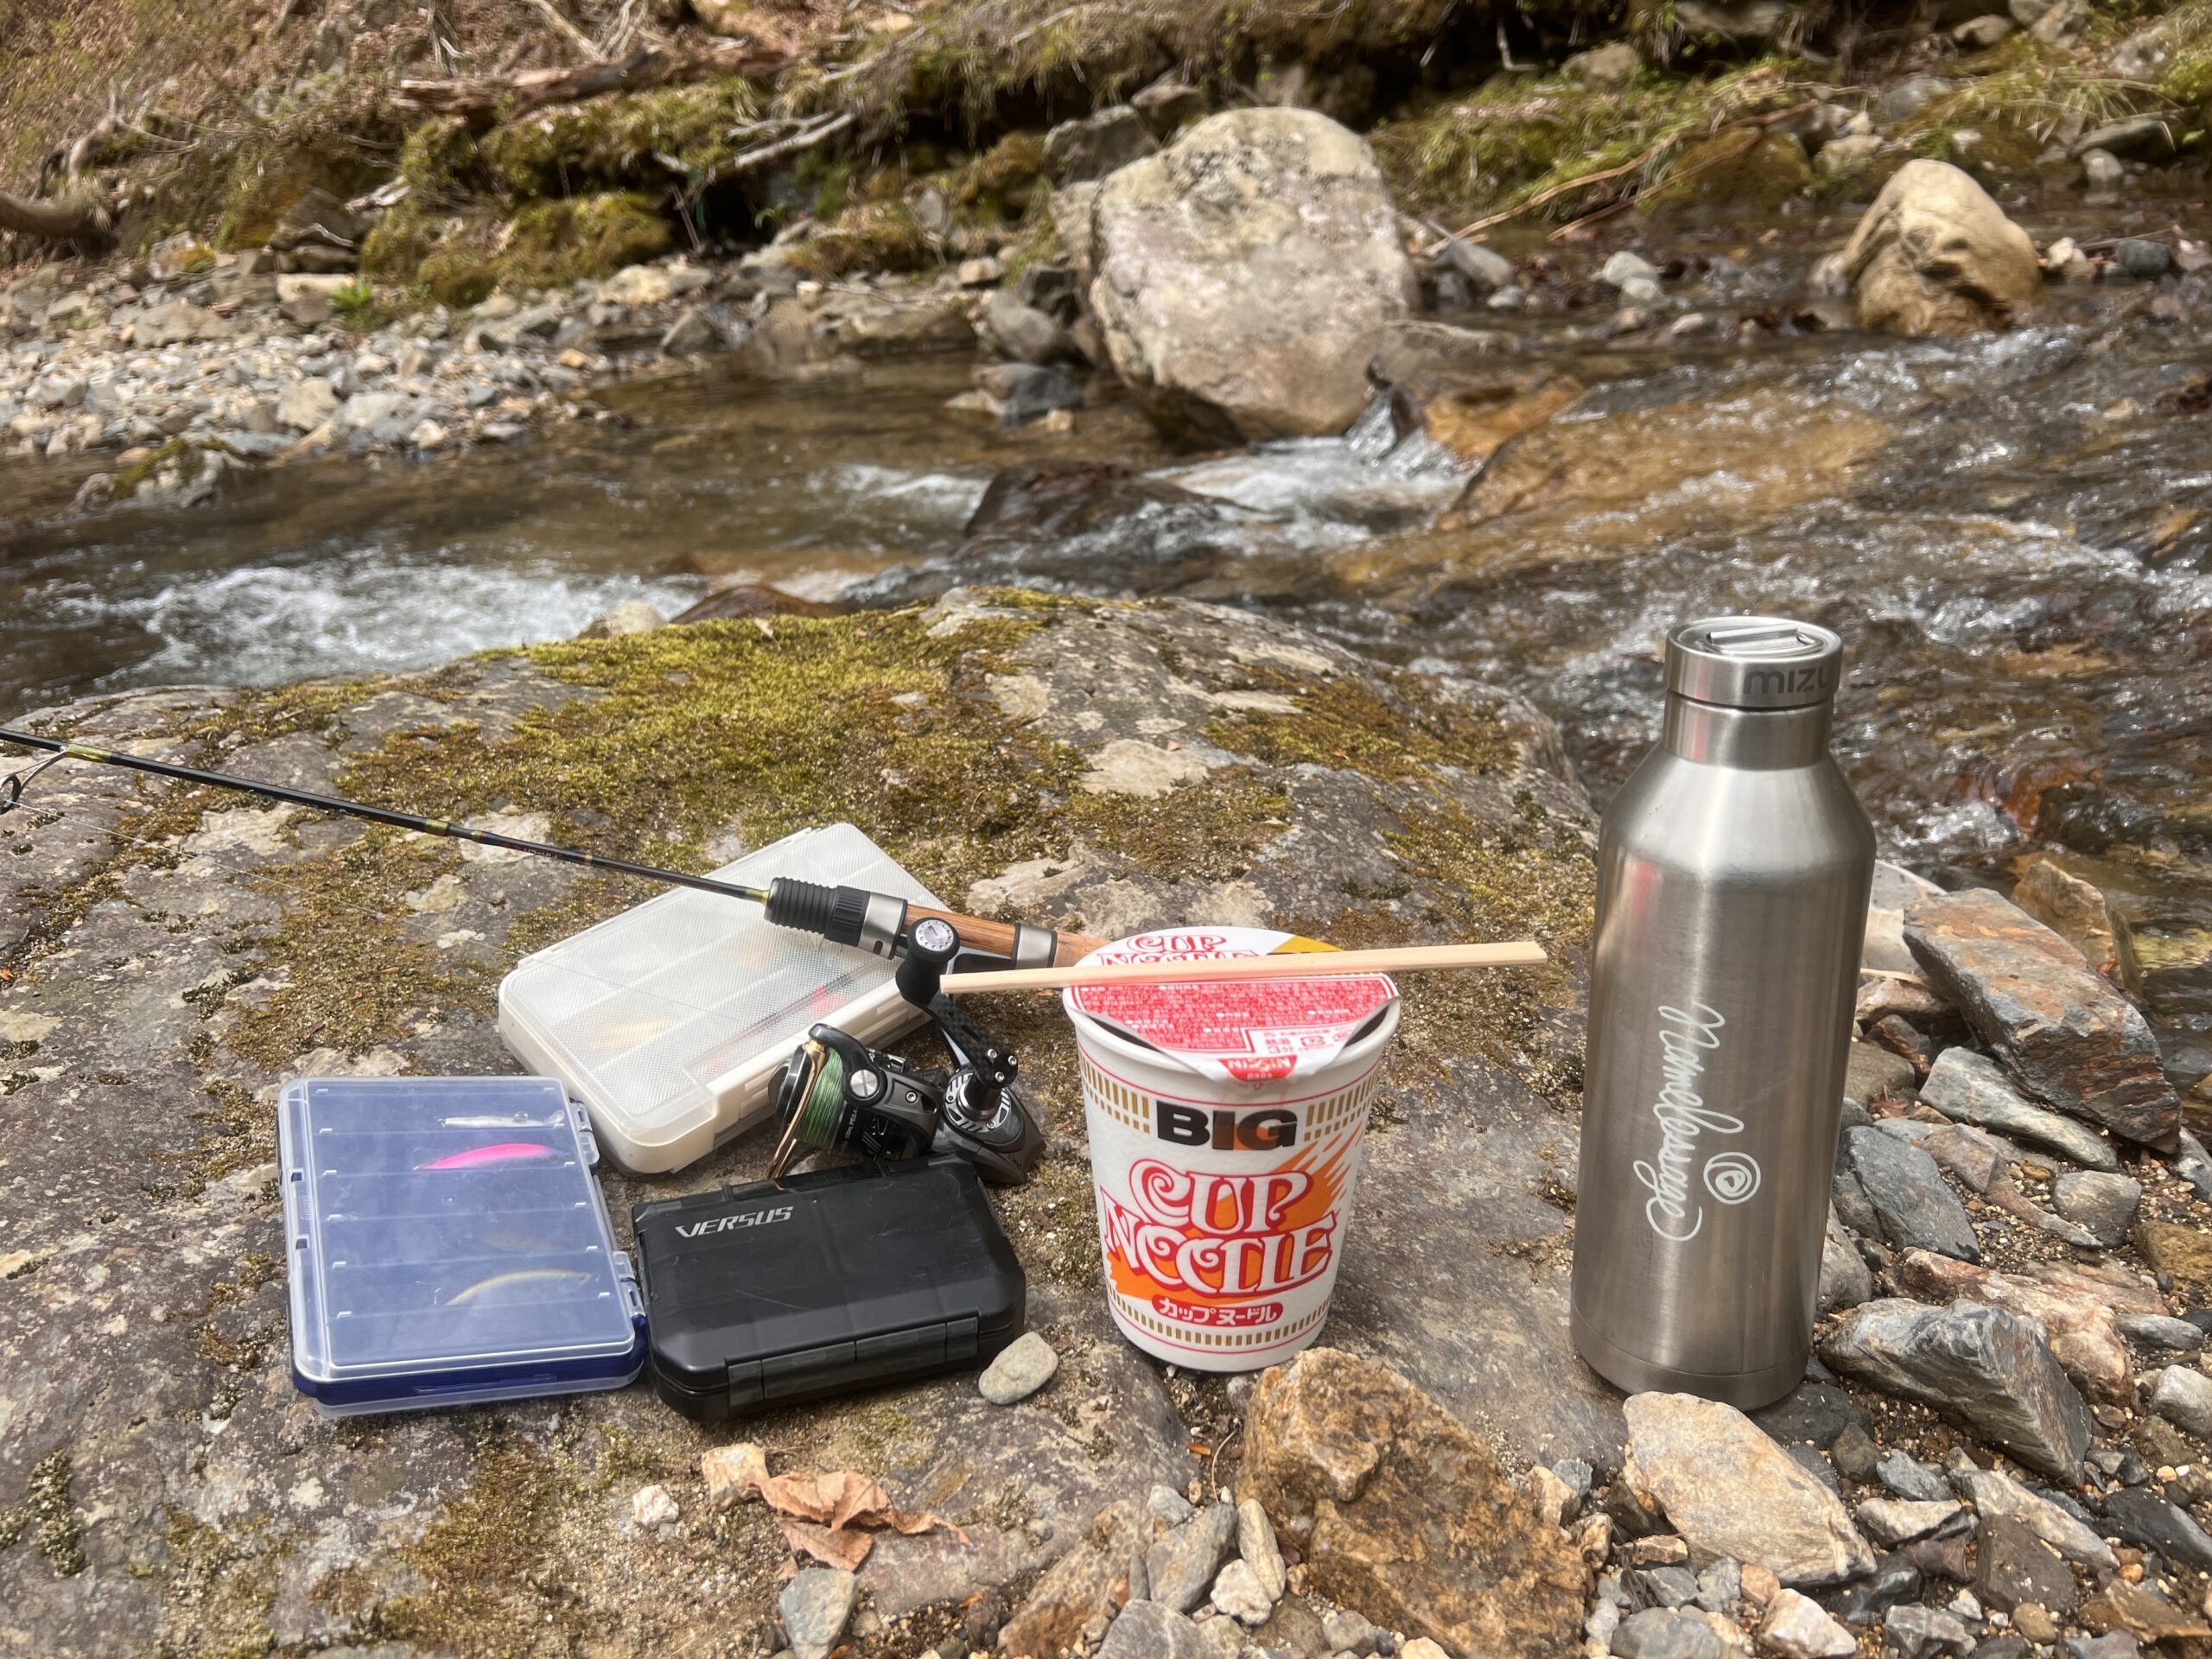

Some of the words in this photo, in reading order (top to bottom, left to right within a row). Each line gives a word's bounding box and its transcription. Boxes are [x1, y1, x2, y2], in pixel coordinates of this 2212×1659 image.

[1127, 935, 1227, 954] CUP
[1227, 1056, 1292, 1072] NISSIN
[1157, 1101, 1297, 1150] BIG
[1129, 1159, 1313, 1236] CUP
[675, 1206, 794, 1238] VERSUS
[1100, 1210, 1337, 1296] NOODLE
